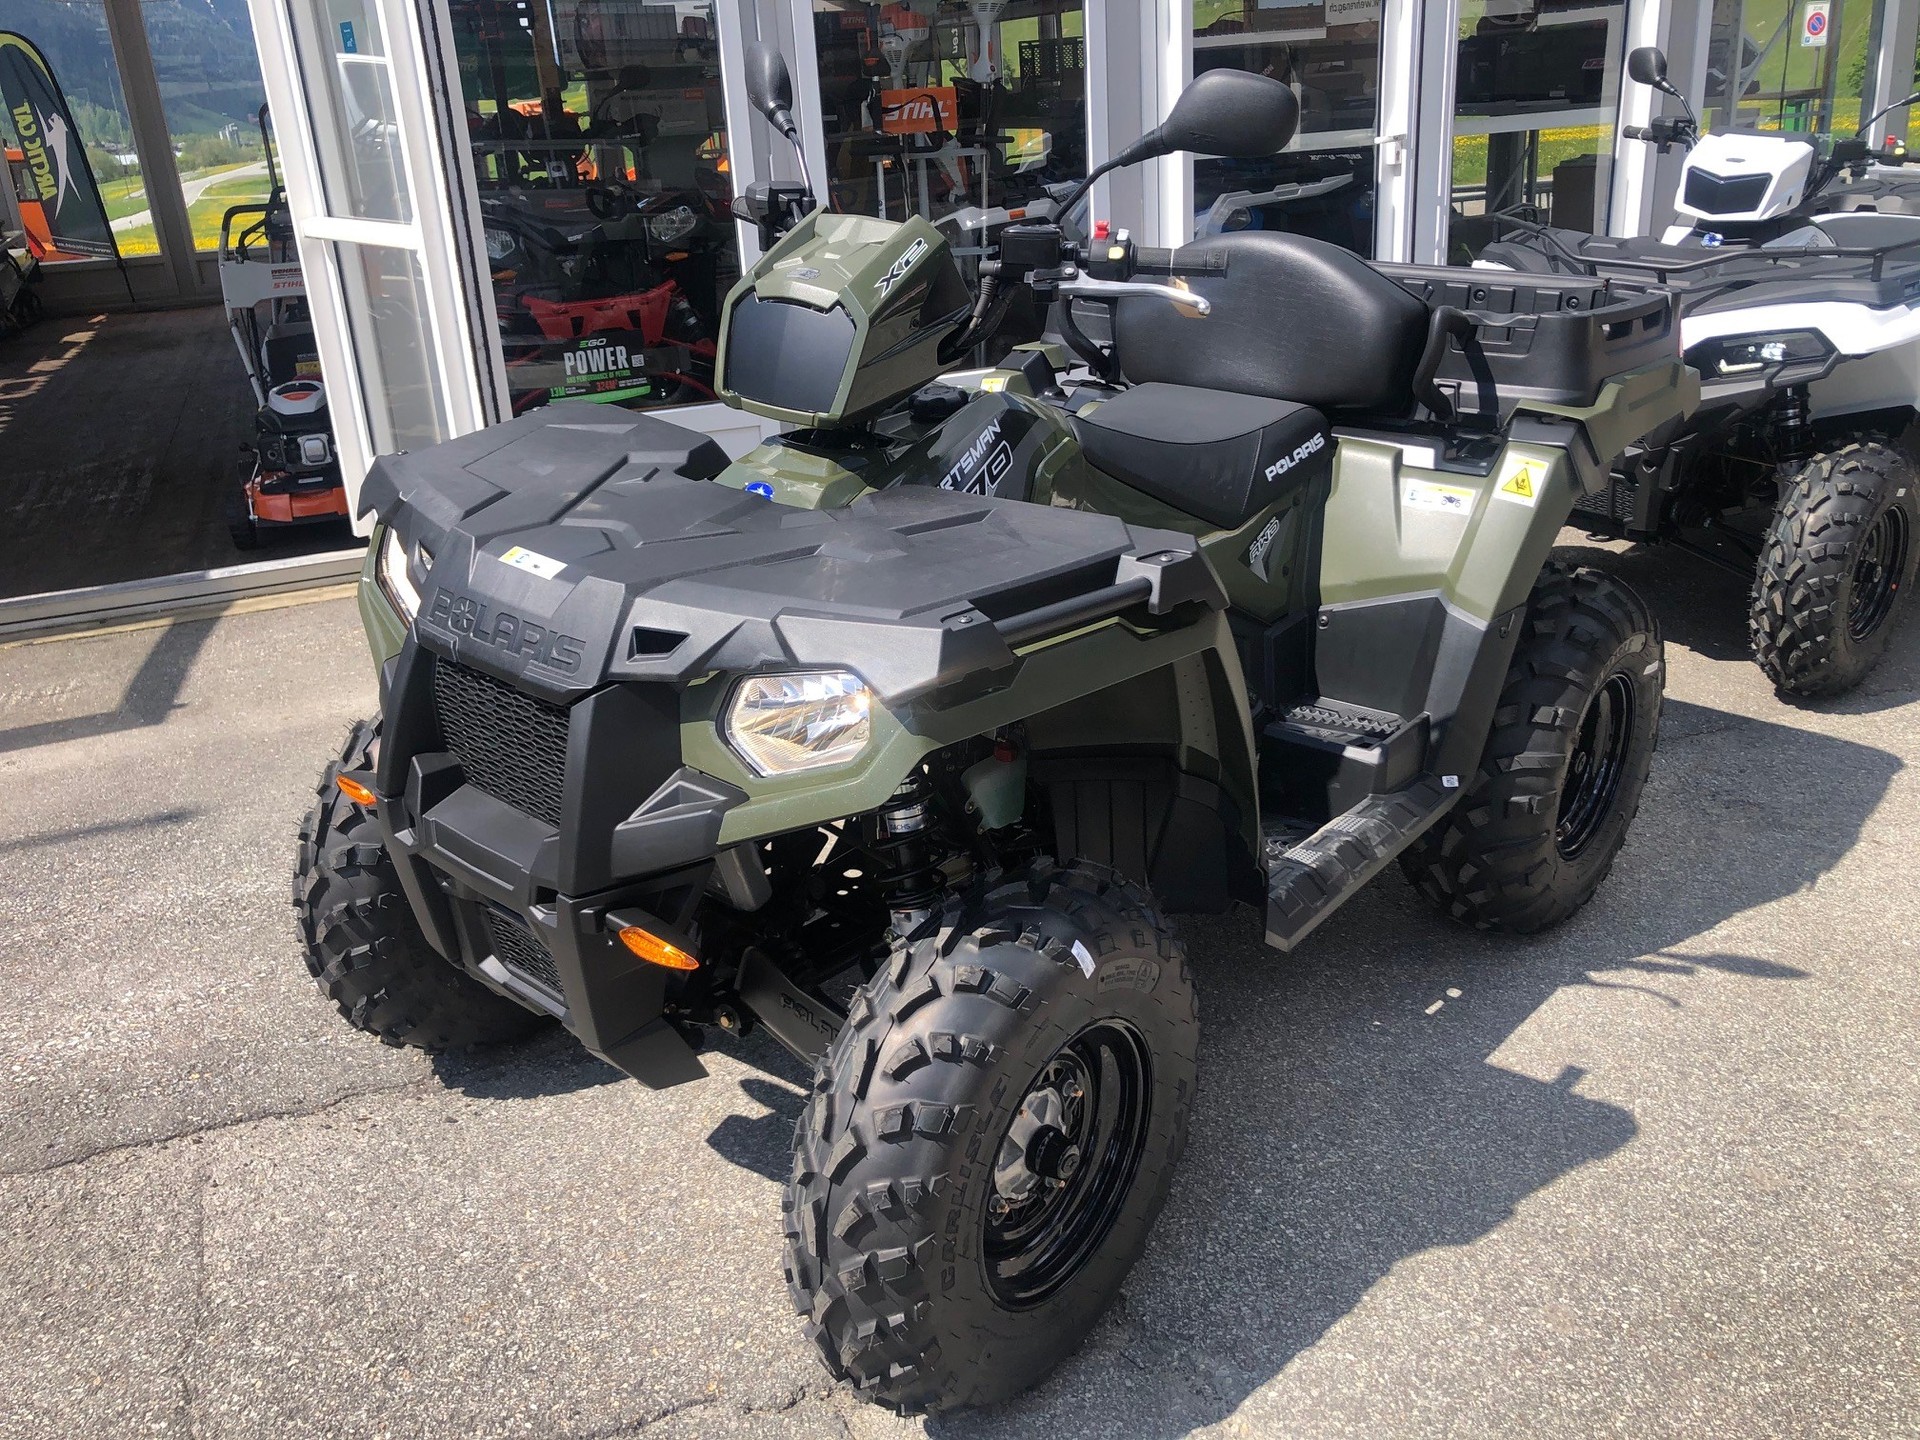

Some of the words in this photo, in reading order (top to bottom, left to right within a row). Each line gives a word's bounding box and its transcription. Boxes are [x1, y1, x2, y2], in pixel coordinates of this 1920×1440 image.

[884, 101, 950, 121] STIHL
[563, 345, 629, 375] POWER
[579, 338, 607, 349] EGO
[939, 417, 1001, 491] RTSMAN
[961, 440, 1014, 497] 70
[1264, 432, 1325, 482] POLARIS
[427, 586, 588, 677] POLARIS
[940, 1076, 1007, 1292] CARLISLE
